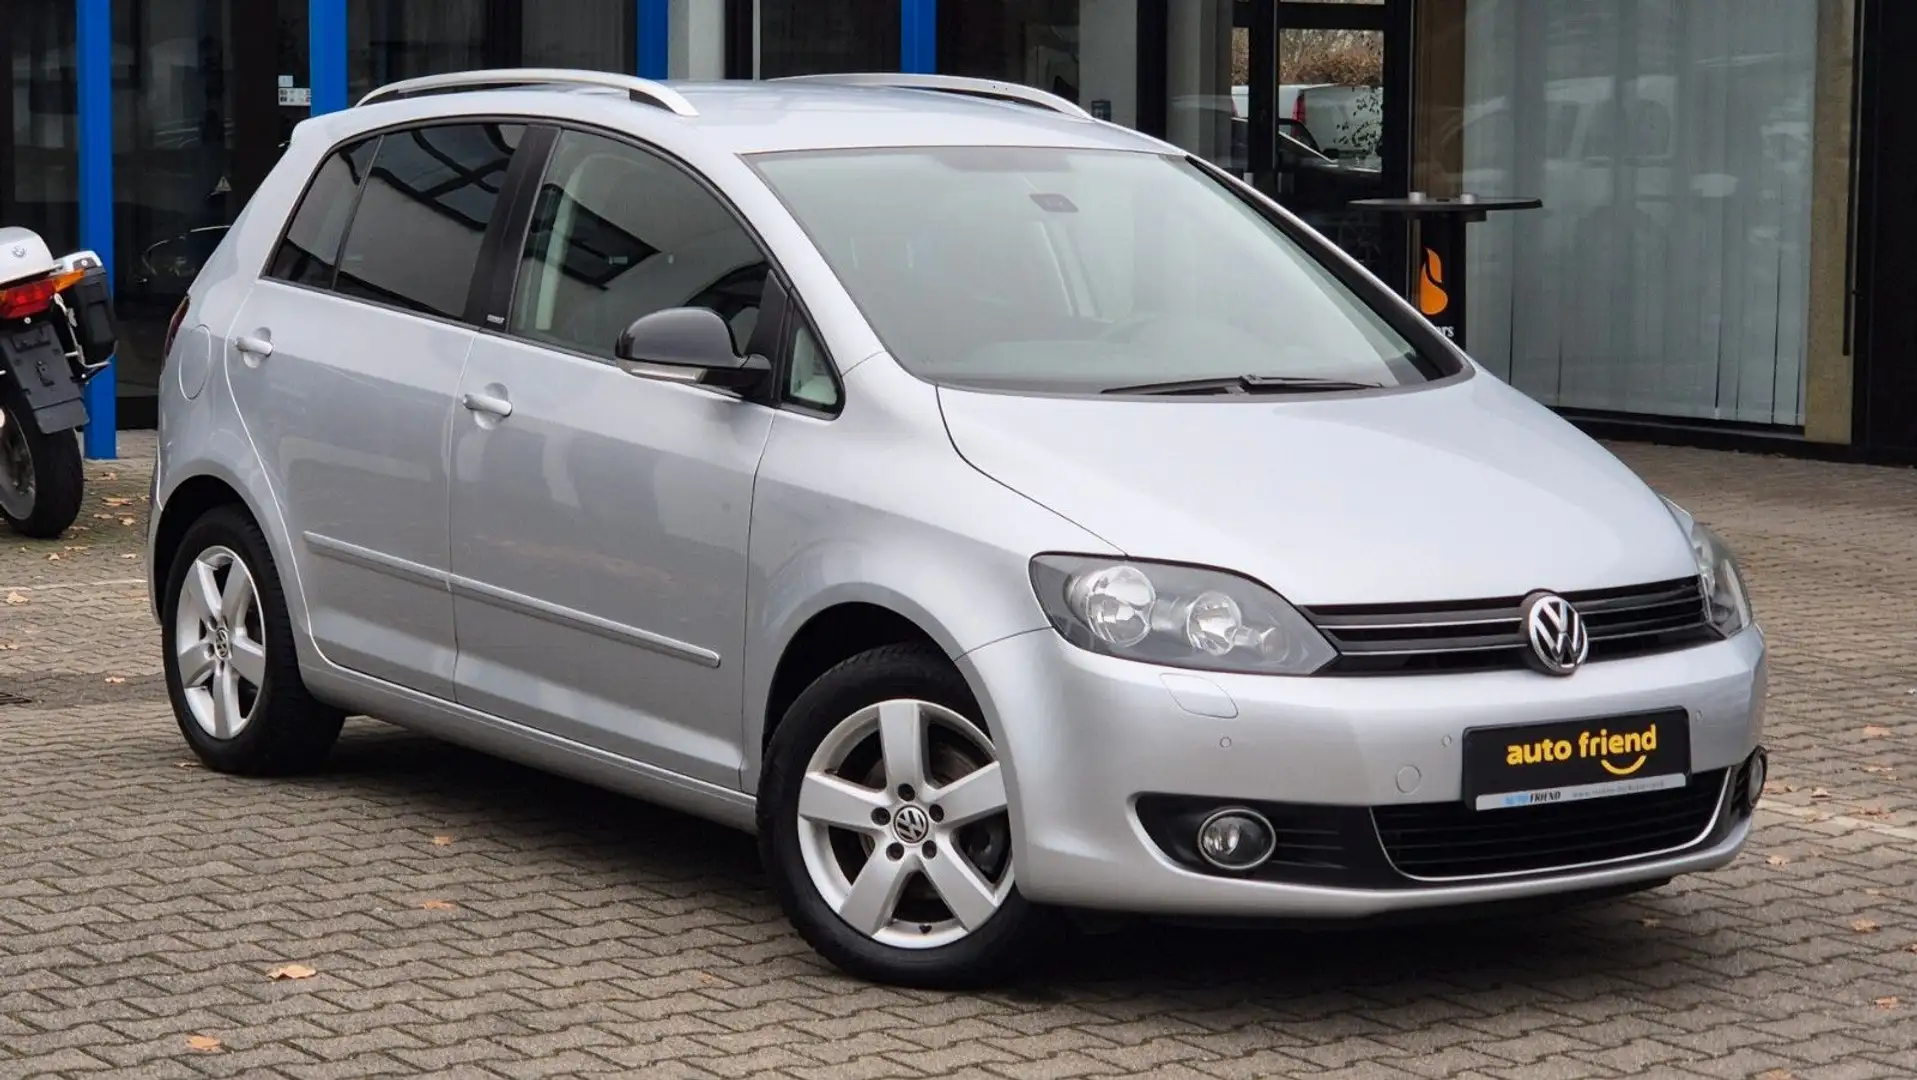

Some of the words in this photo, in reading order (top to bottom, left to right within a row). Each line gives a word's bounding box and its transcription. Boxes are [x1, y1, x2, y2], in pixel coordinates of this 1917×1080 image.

[1529, 594, 1589, 670] VW
[1506, 738, 1572, 766] auto
[1578, 723, 1658, 758] friend
